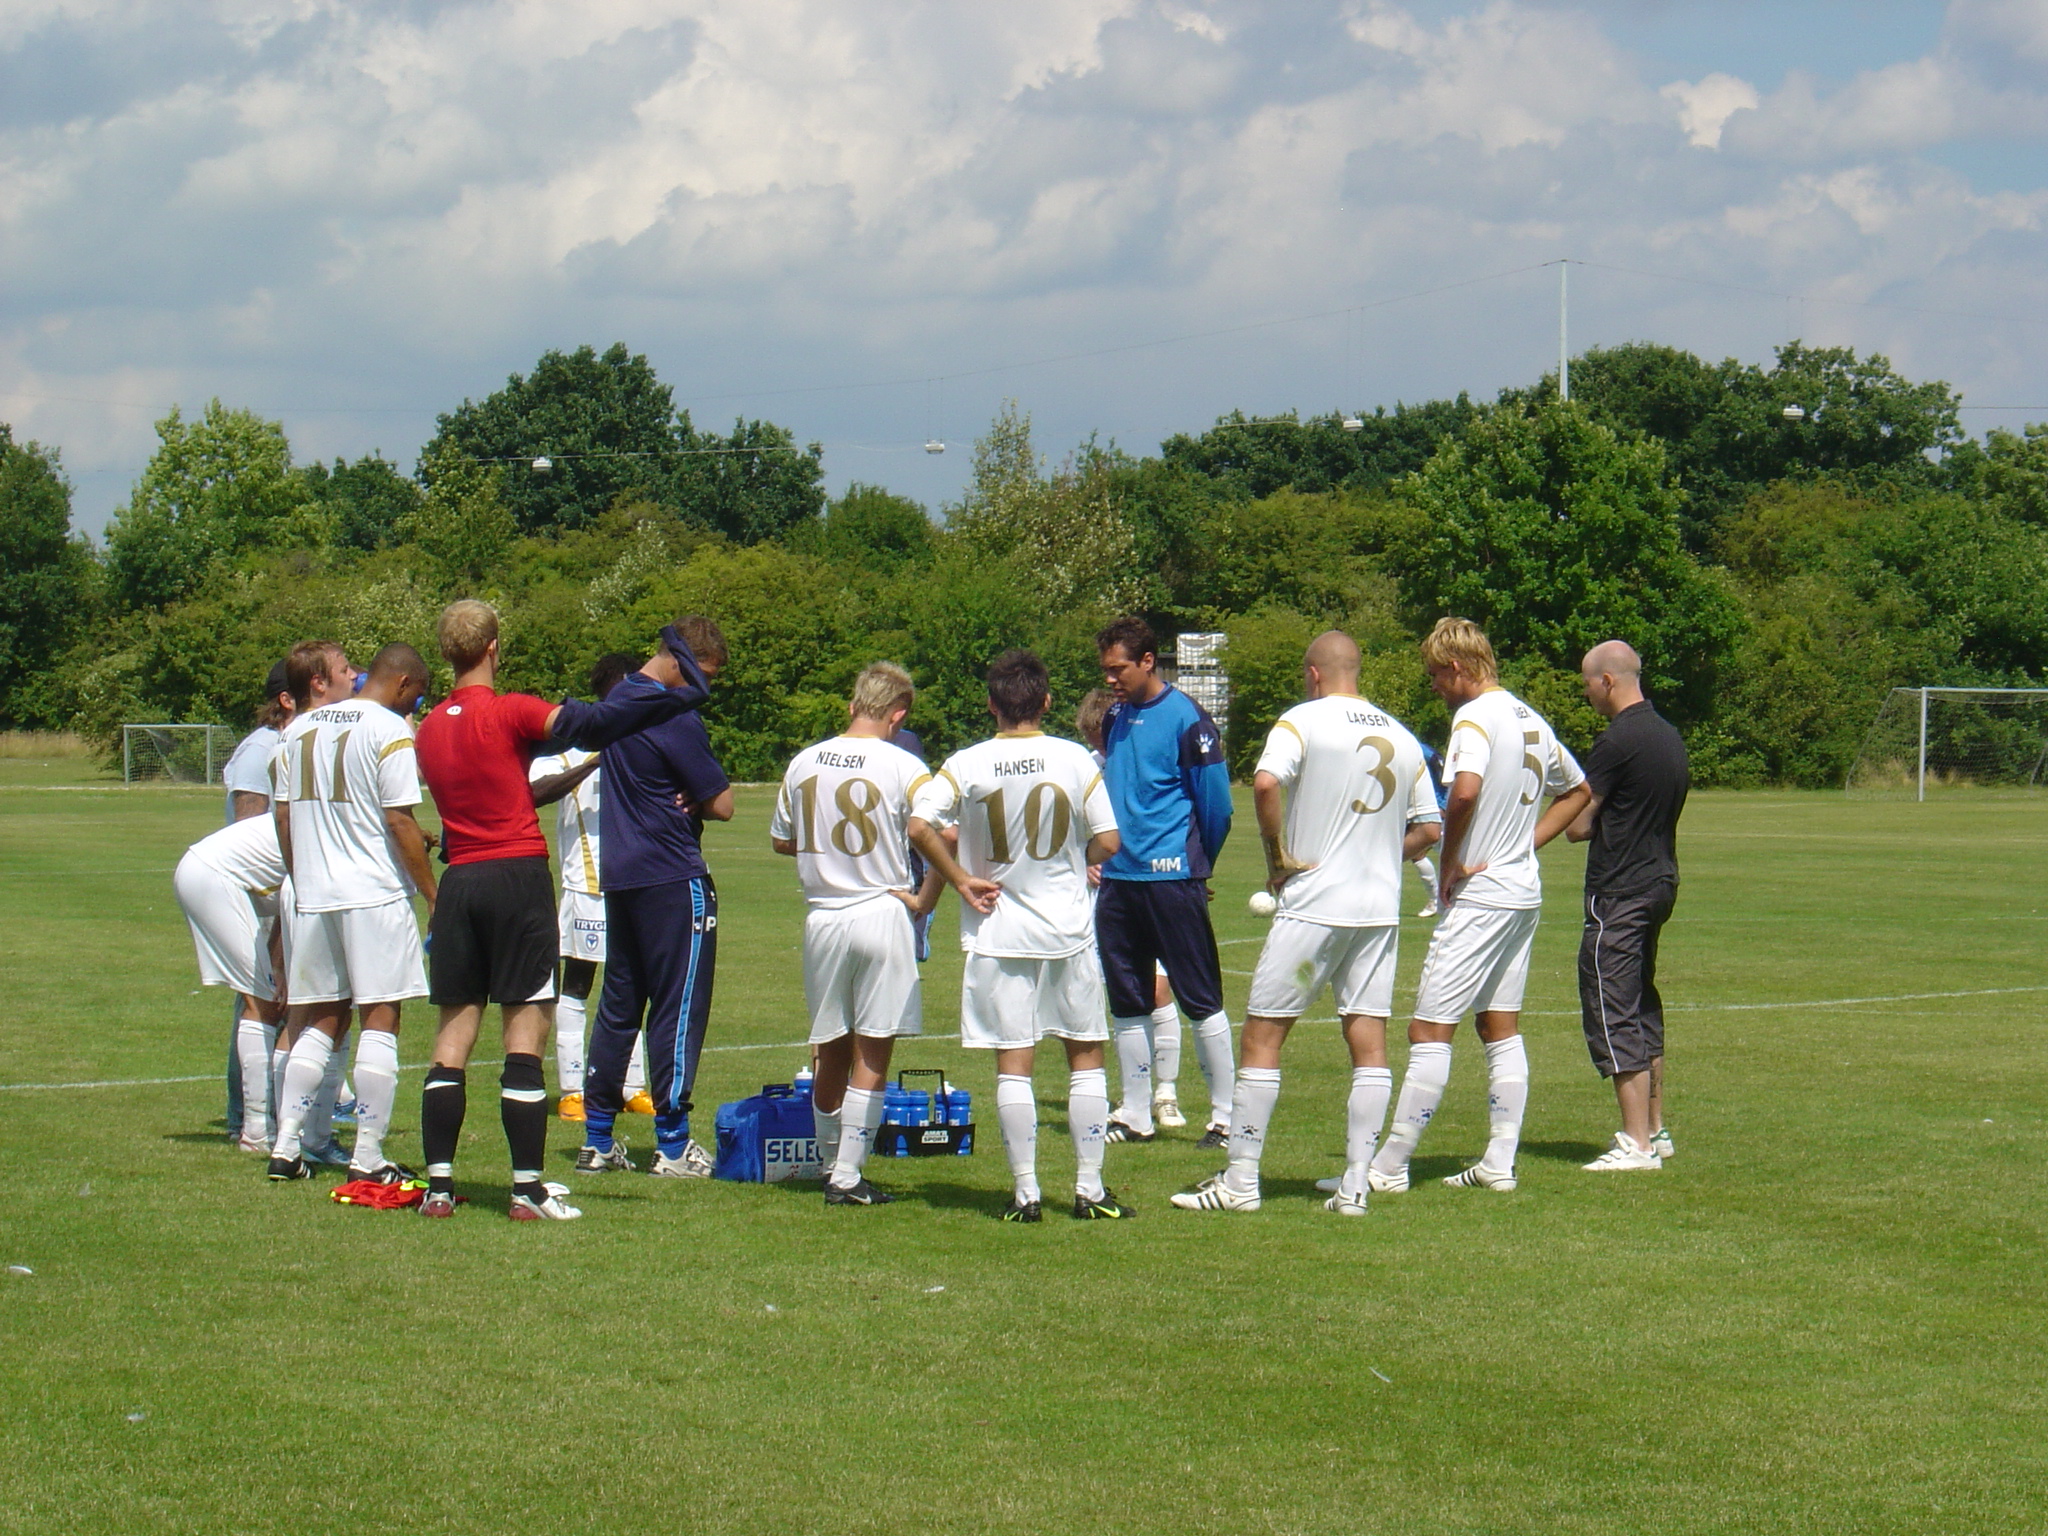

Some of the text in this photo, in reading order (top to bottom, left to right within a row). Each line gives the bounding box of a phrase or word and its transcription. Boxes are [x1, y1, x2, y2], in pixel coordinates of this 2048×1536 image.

[308, 709, 364, 723] MORTENSEN
[1346, 711, 1390, 728] LARSEN
[293, 727, 354, 803] 11
[815, 751, 866, 769] NIELSEN
[994, 758, 1045, 777] HANSEN
[1351, 735, 1397, 815] 3
[1520, 730, 1544, 806] 5
[794, 774, 881, 857] 18
[976, 782, 1070, 864] 10
[1152, 857, 1181, 873] MM
